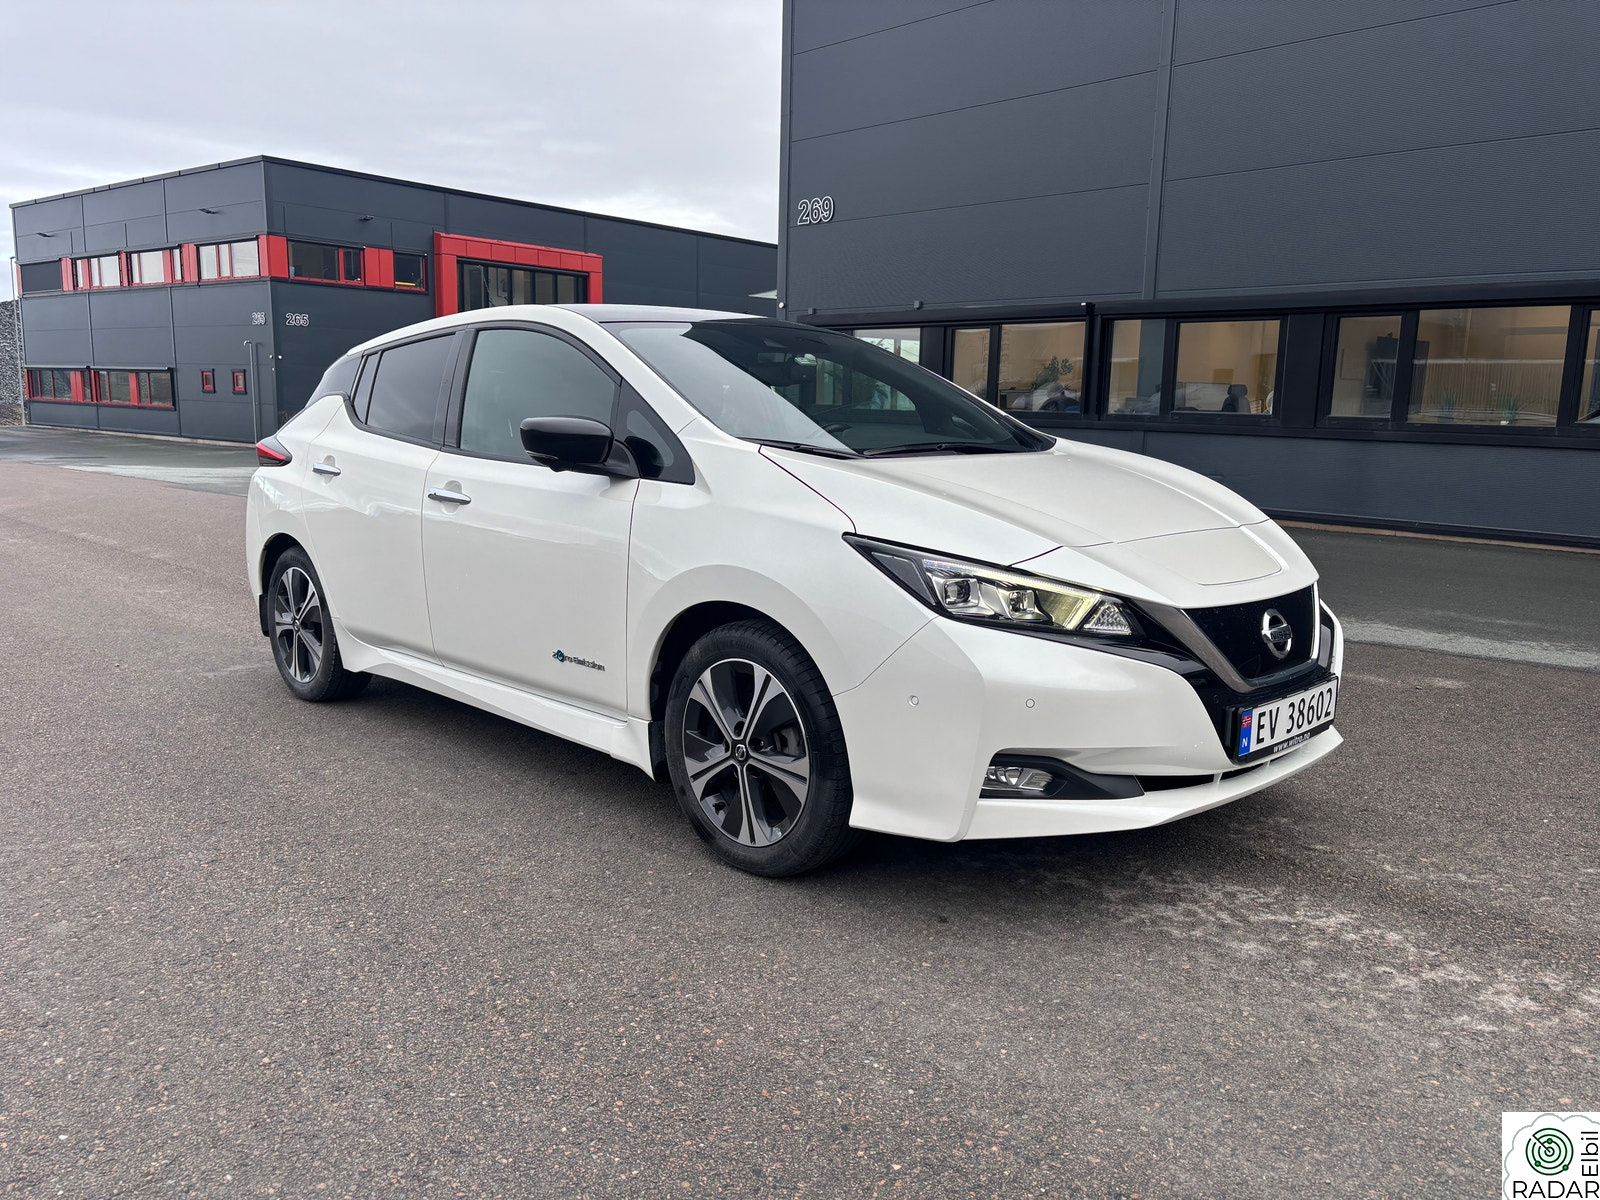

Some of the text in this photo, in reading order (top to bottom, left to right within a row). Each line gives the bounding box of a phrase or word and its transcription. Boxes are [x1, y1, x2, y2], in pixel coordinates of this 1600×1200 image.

[797, 196, 834, 225] 269
[285, 312, 310, 327] 265
[1256, 687, 1333, 745] EV 38602
[1242, 737, 1248, 748] N
